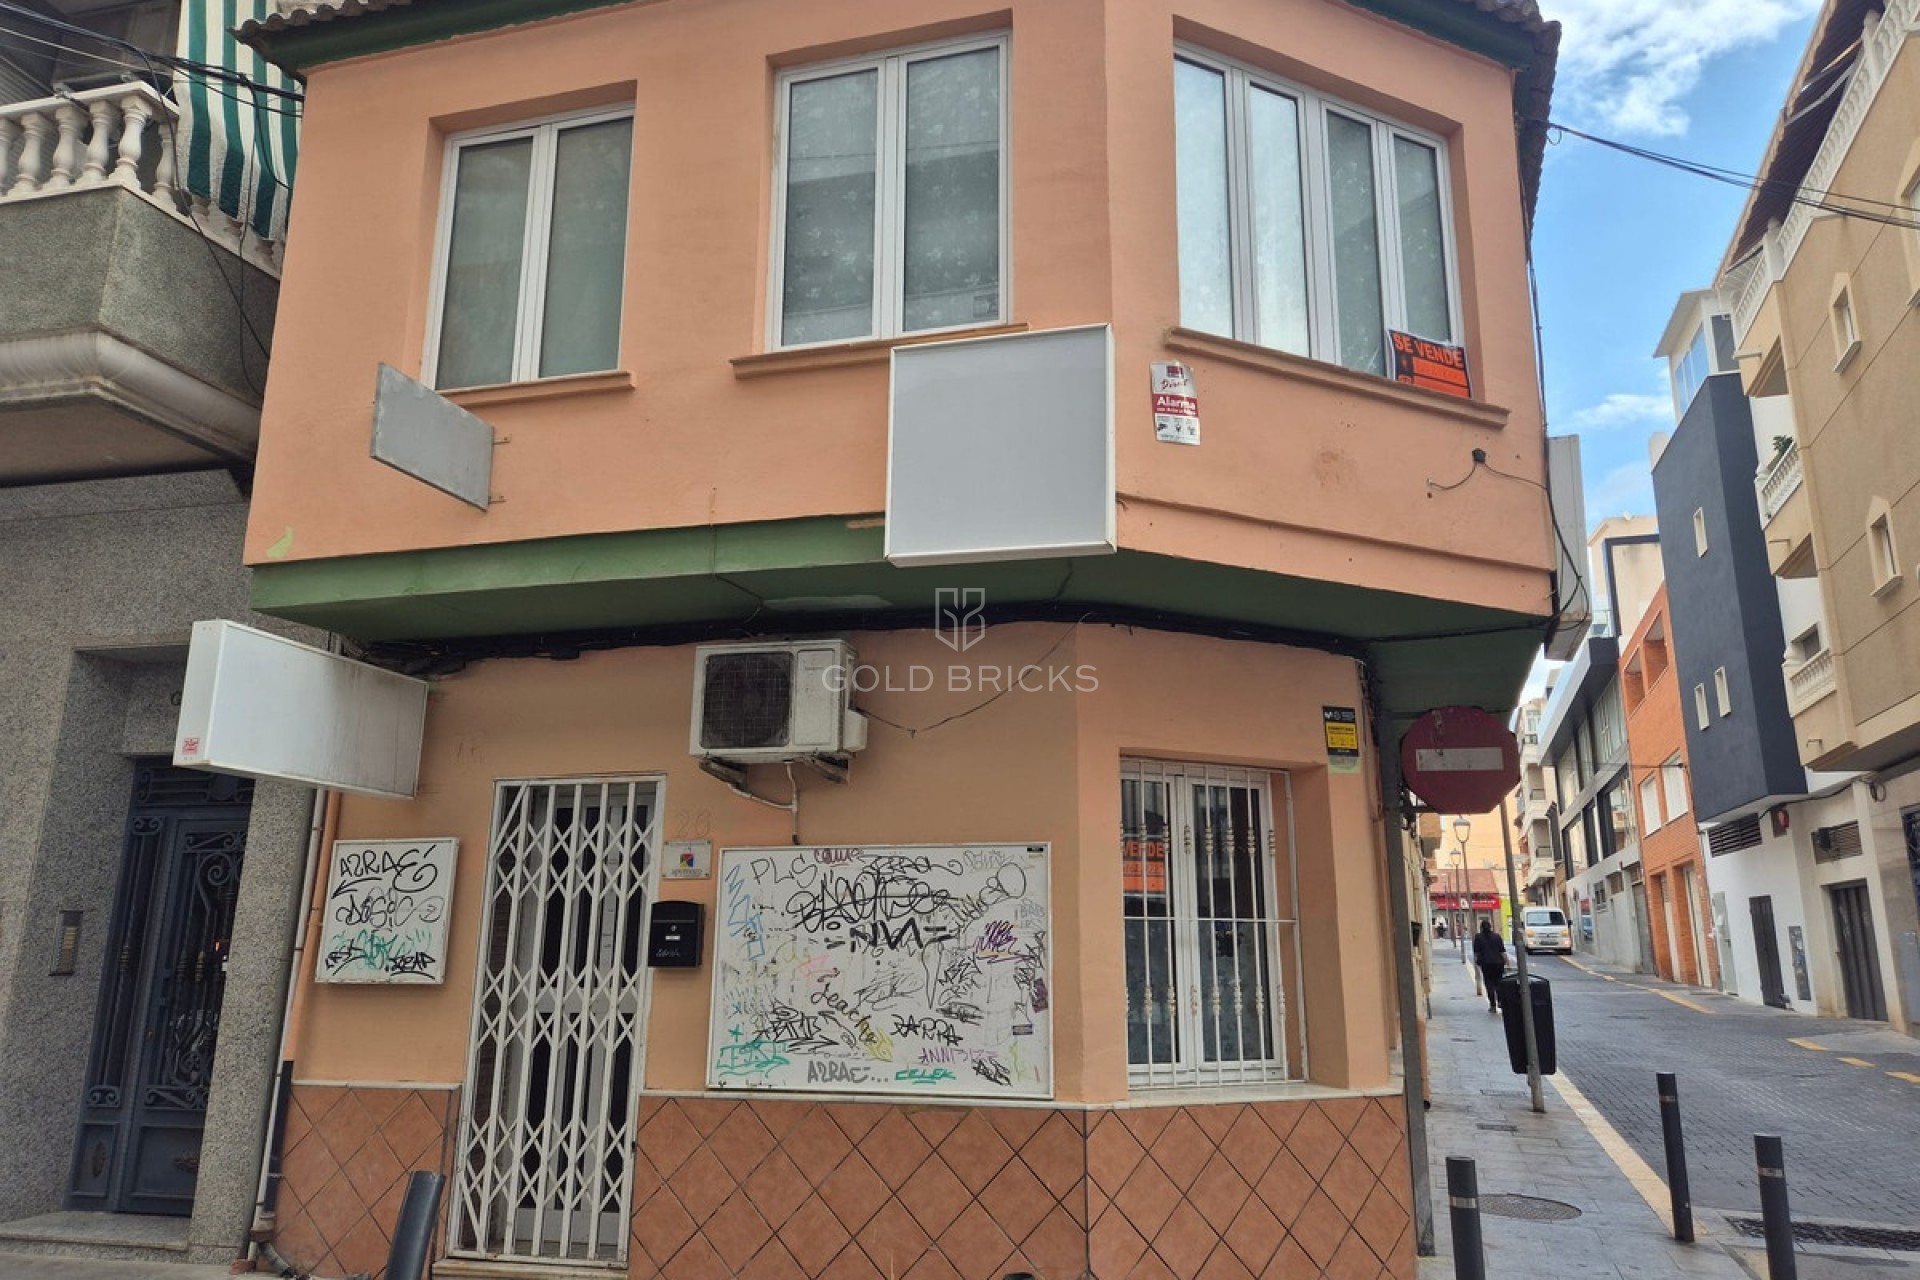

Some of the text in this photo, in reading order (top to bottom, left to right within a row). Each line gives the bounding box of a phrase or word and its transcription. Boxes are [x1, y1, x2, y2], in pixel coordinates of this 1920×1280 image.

[1393, 331, 1464, 367] SE VENDE
[1123, 841, 1165, 857] VEDE
